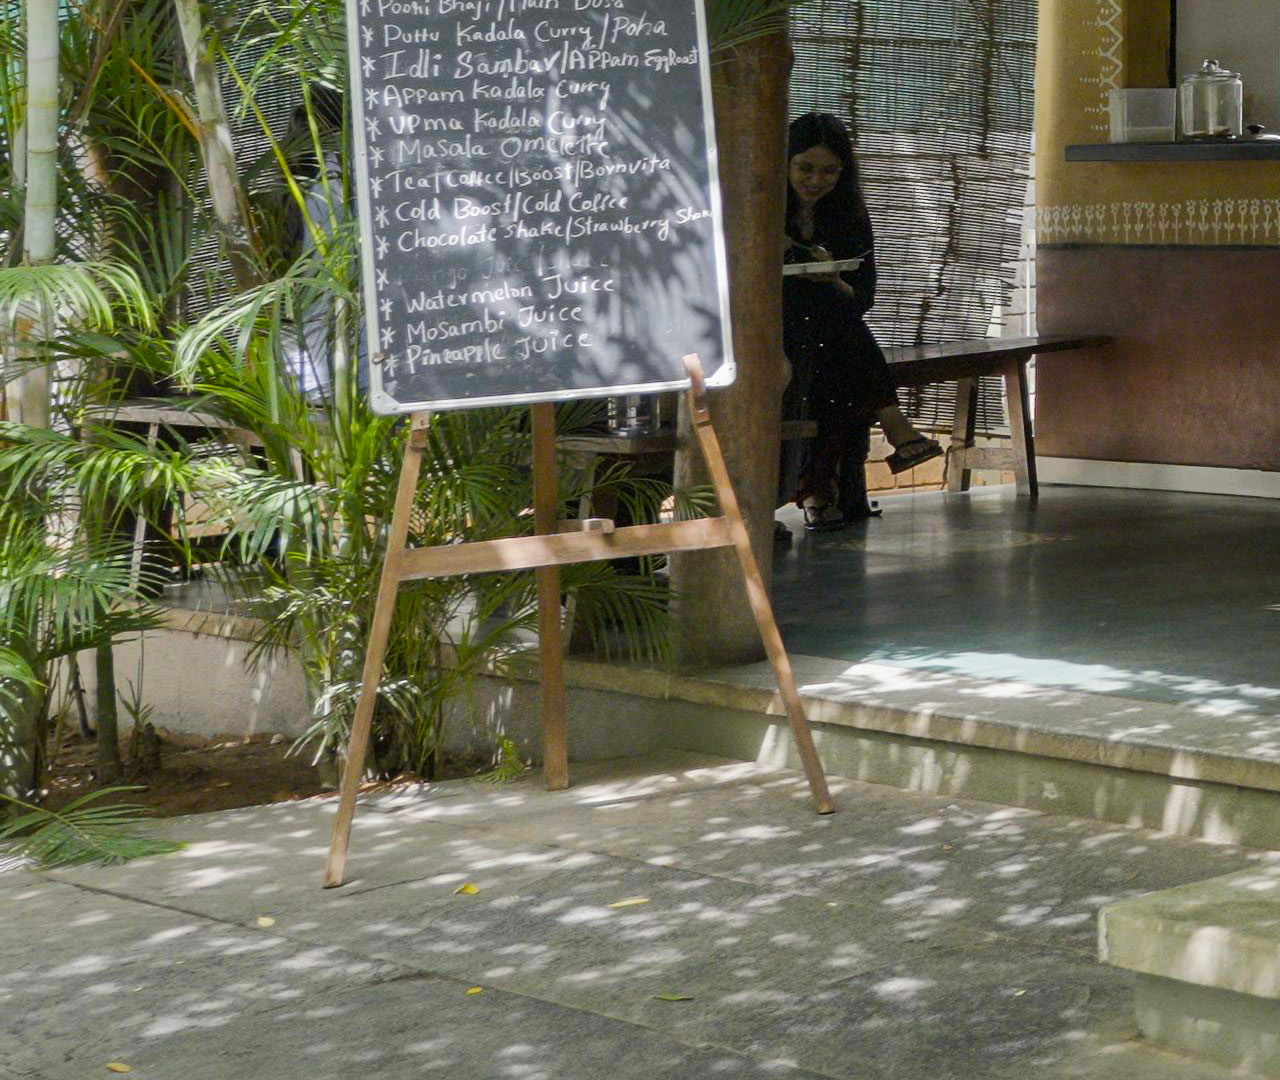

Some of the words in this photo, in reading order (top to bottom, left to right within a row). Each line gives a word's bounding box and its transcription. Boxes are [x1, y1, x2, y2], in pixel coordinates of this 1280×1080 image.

[384, 24, 440, 47] Puttu
[456, 18, 526, 46] Kadala
[380, 48, 442, 80] Idli
[472, 76, 545, 100] Kadala
[555, 79, 611, 110] Curry
[474, 105, 542, 133] Kadala
[547, 110, 608, 140] Curry
[395, 197, 441, 221] Cold
[569, 191, 628, 213] Coffee
[398, 223, 497, 252] Chocolate
[407, 281, 533, 314] Watermelon
[543, 273, 615, 300] Juice
[519, 304, 582, 328] Juice
[515, 331, 593, 360] Juice
